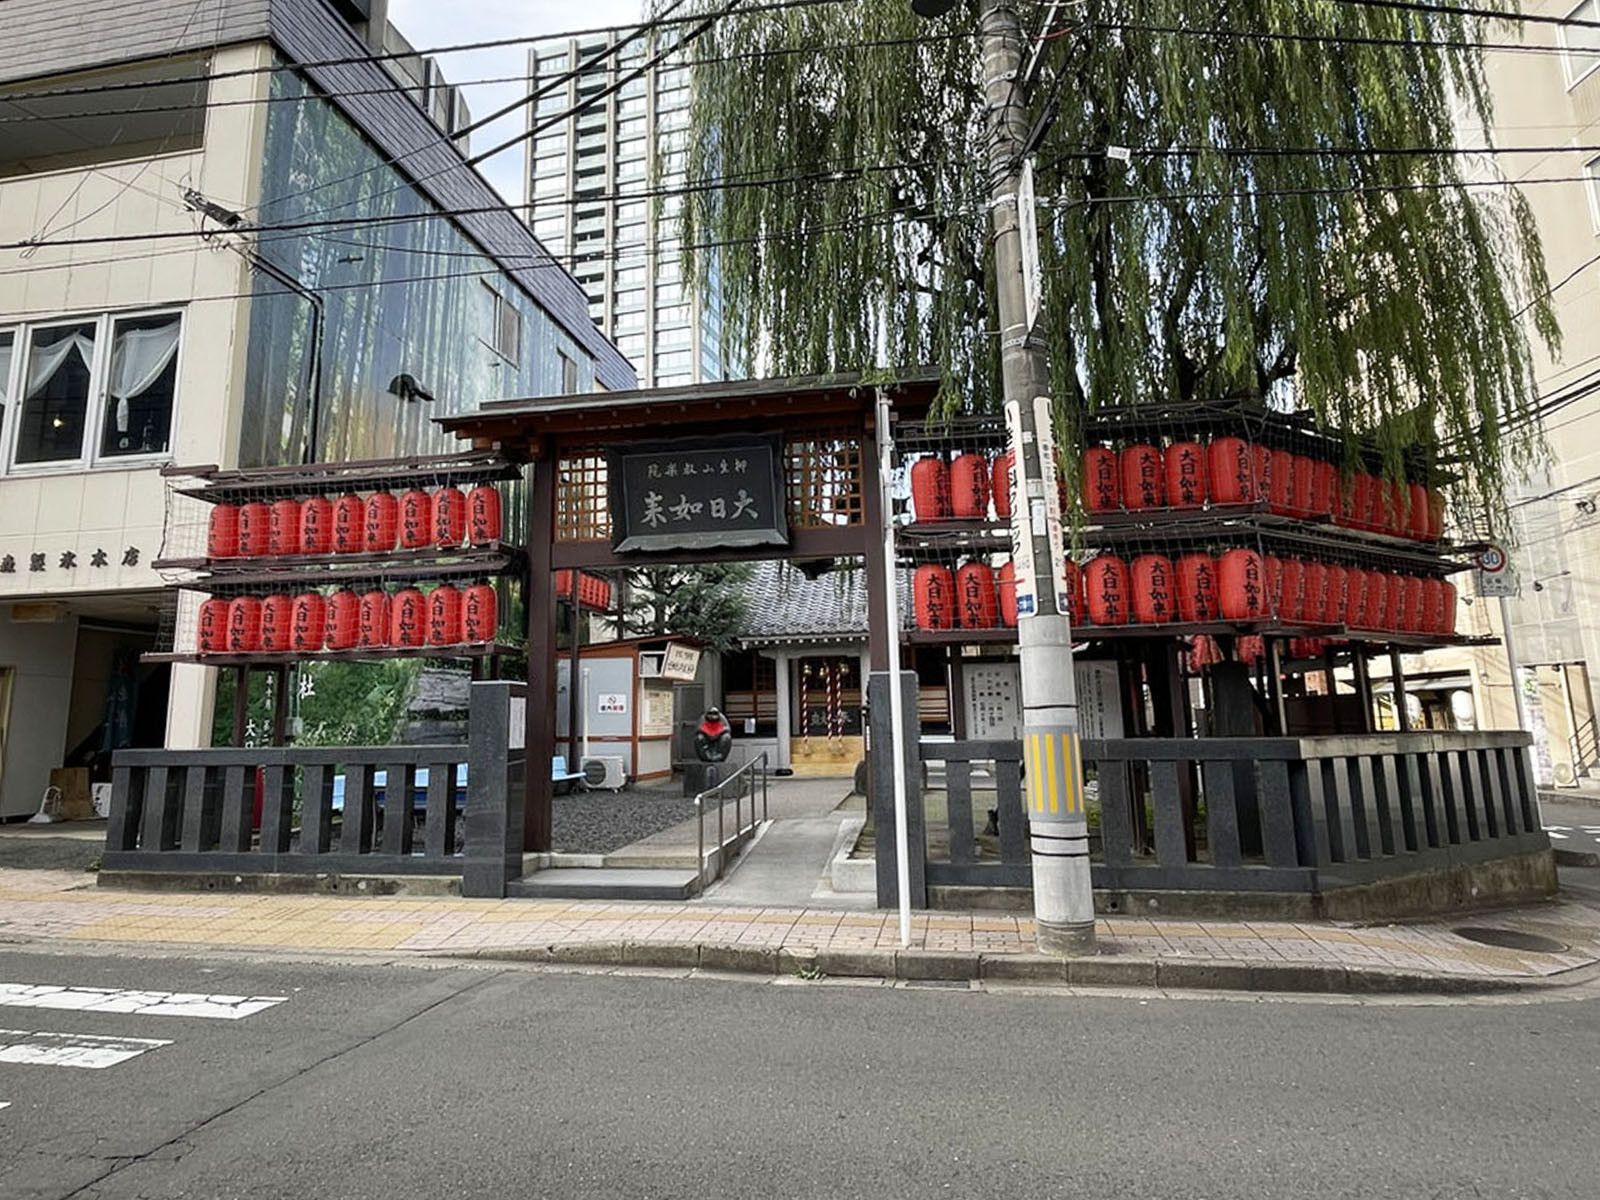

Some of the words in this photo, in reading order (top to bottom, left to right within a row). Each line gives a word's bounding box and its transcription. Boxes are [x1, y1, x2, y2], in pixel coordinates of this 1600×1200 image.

[1097, 455, 1114, 507] 大日如来
[1140, 452, 1156, 506] 大日如来
[1179, 450, 1197, 504] 大日如来
[640, 489, 759, 528] 大日如来
[926, 574, 943, 627] 大日如来
[966, 573, 982, 626] 大日如来
[1102, 564, 1120, 618] 大日如来
[1150, 561, 1168, 616] 大日如来
[1195, 564, 1213, 619] 大日如来
[1243, 555, 1260, 611] 大日如来
